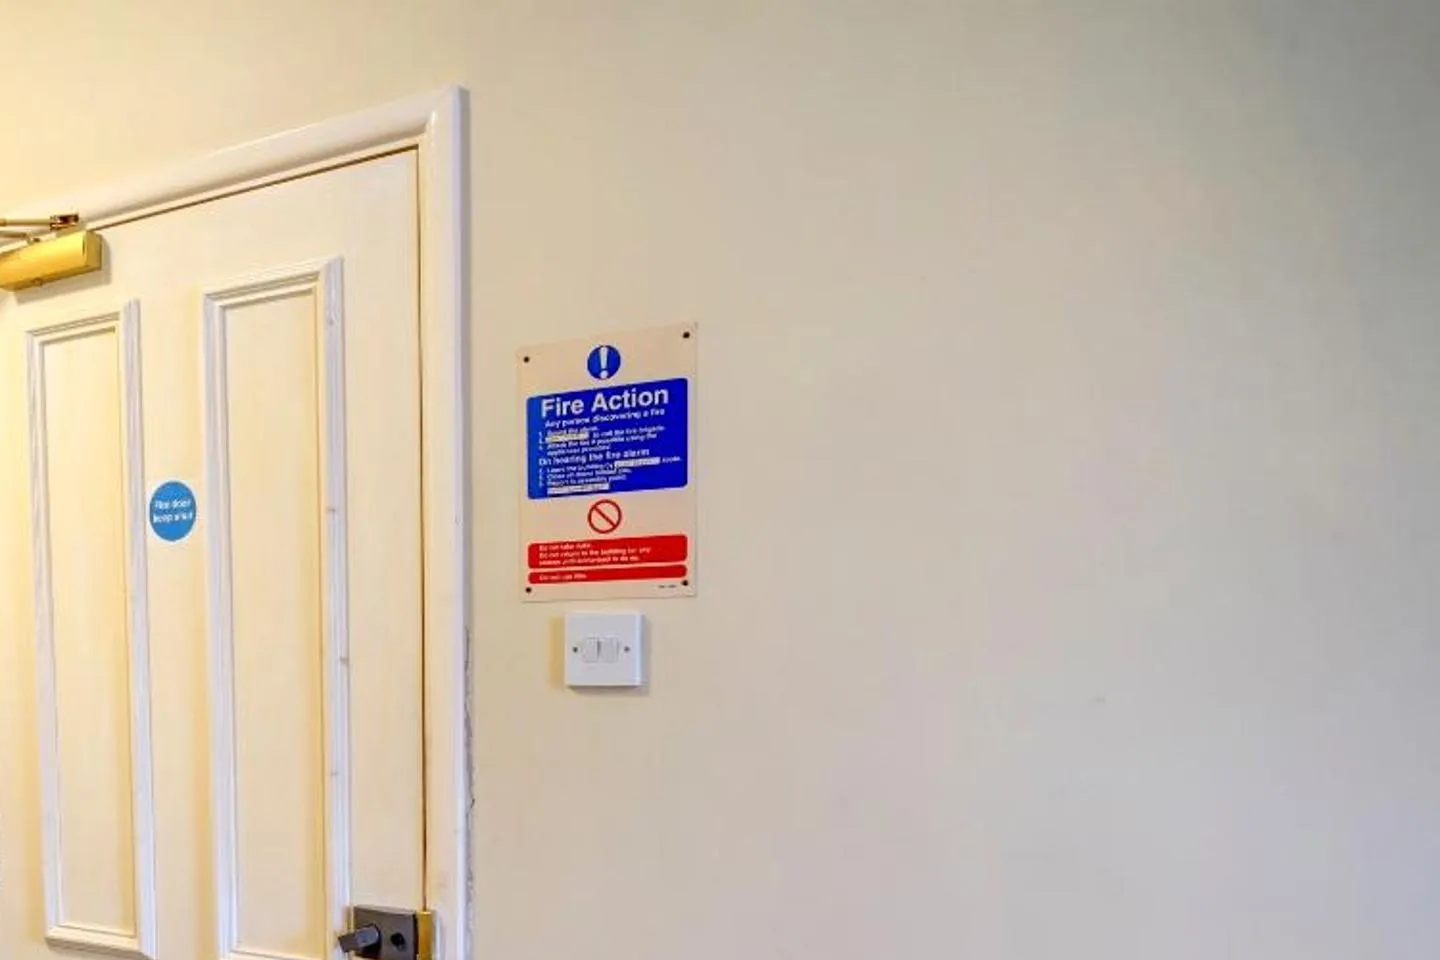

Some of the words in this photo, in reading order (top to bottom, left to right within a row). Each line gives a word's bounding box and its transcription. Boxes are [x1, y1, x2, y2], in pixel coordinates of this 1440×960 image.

[541, 397, 585, 418] Fire
[591, 388, 669, 412] Action
[592, 411, 641, 423] discovering
[650, 408, 665, 416] fire
[539, 457, 552, 467] On
[553, 454, 587, 465] hearing
[589, 452, 604, 461] the
[606, 450, 621, 459] fire
[623, 448, 650, 458] alarm
[171, 498, 190, 508] door
